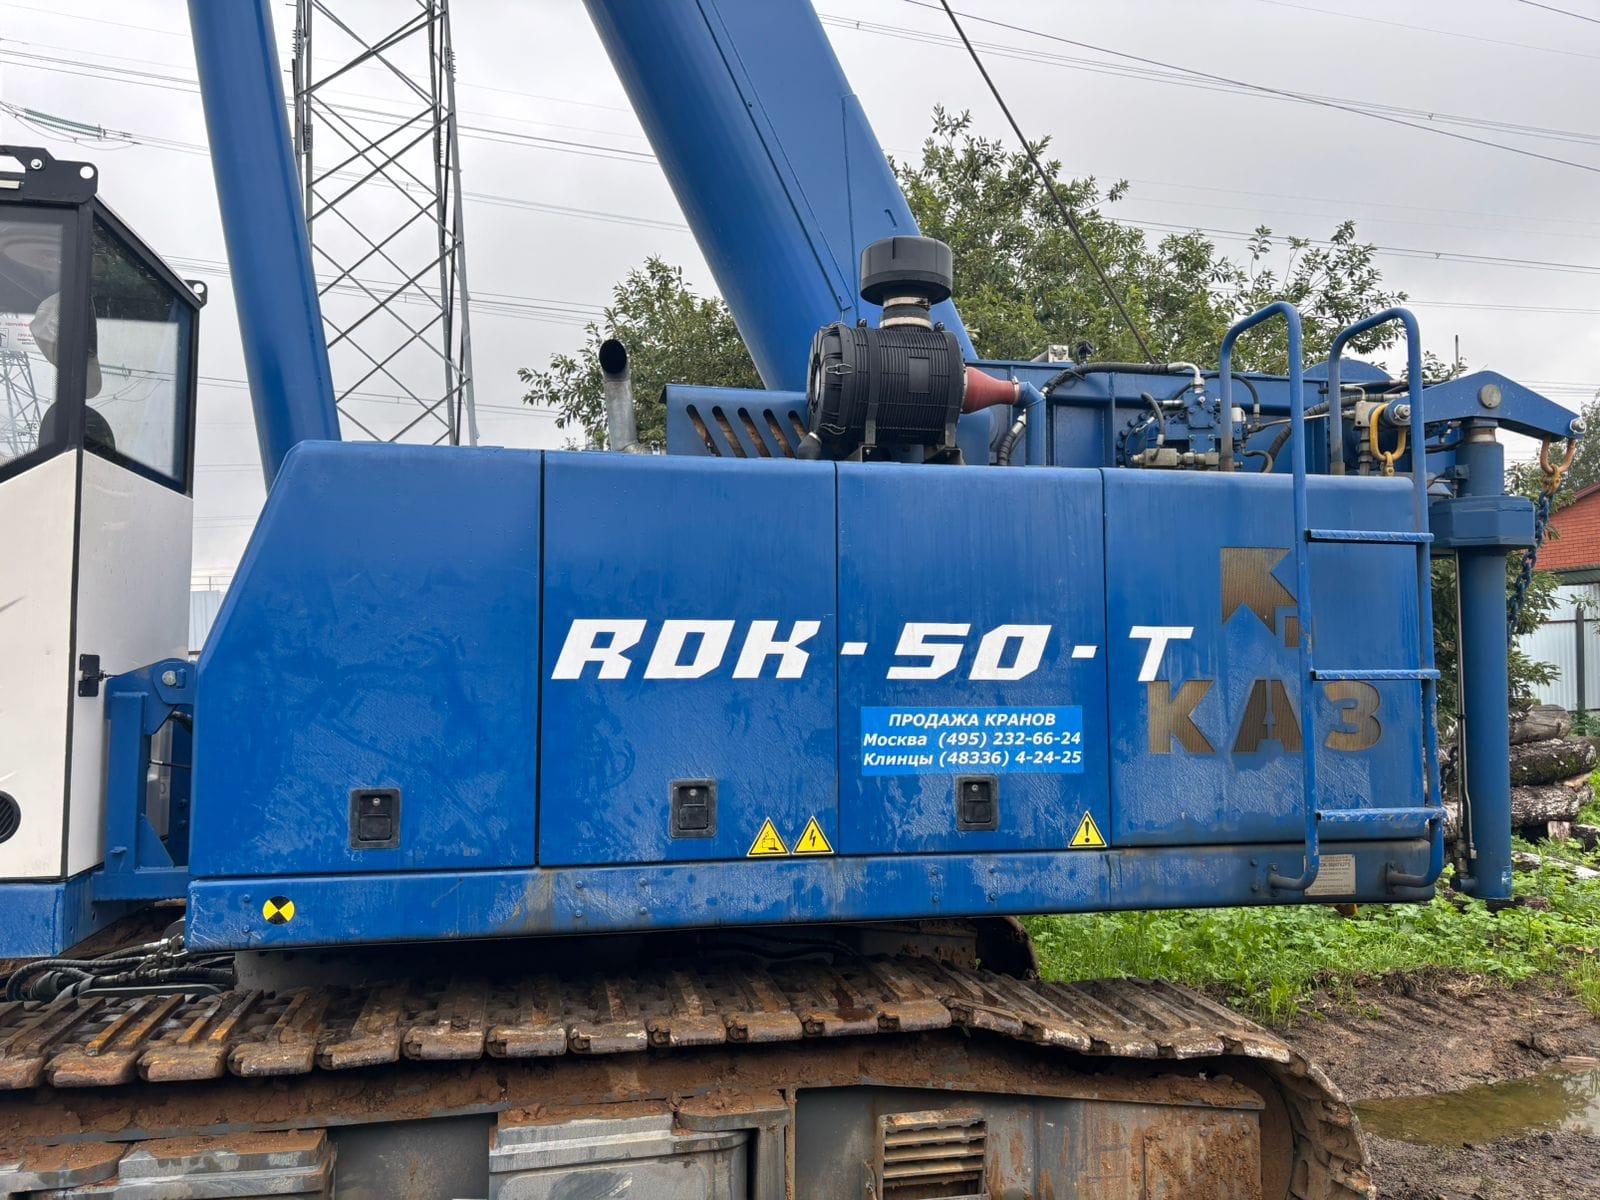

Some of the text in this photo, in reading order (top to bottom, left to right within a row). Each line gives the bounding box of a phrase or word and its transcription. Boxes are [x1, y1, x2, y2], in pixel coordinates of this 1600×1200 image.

[551, 618, 821, 680] RDK
[886, 621, 1052, 682] 50
[1128, 625, 1195, 682] T
[888, 713, 1057, 729] ПРОДАЖА КРАНОВ
[1147, 680, 1382, 754] КАЗ
[863, 731, 1081, 749] Москва (495) 232-66-24
[863, 750, 1082, 768] Клинцы (48336) 4-24-25
